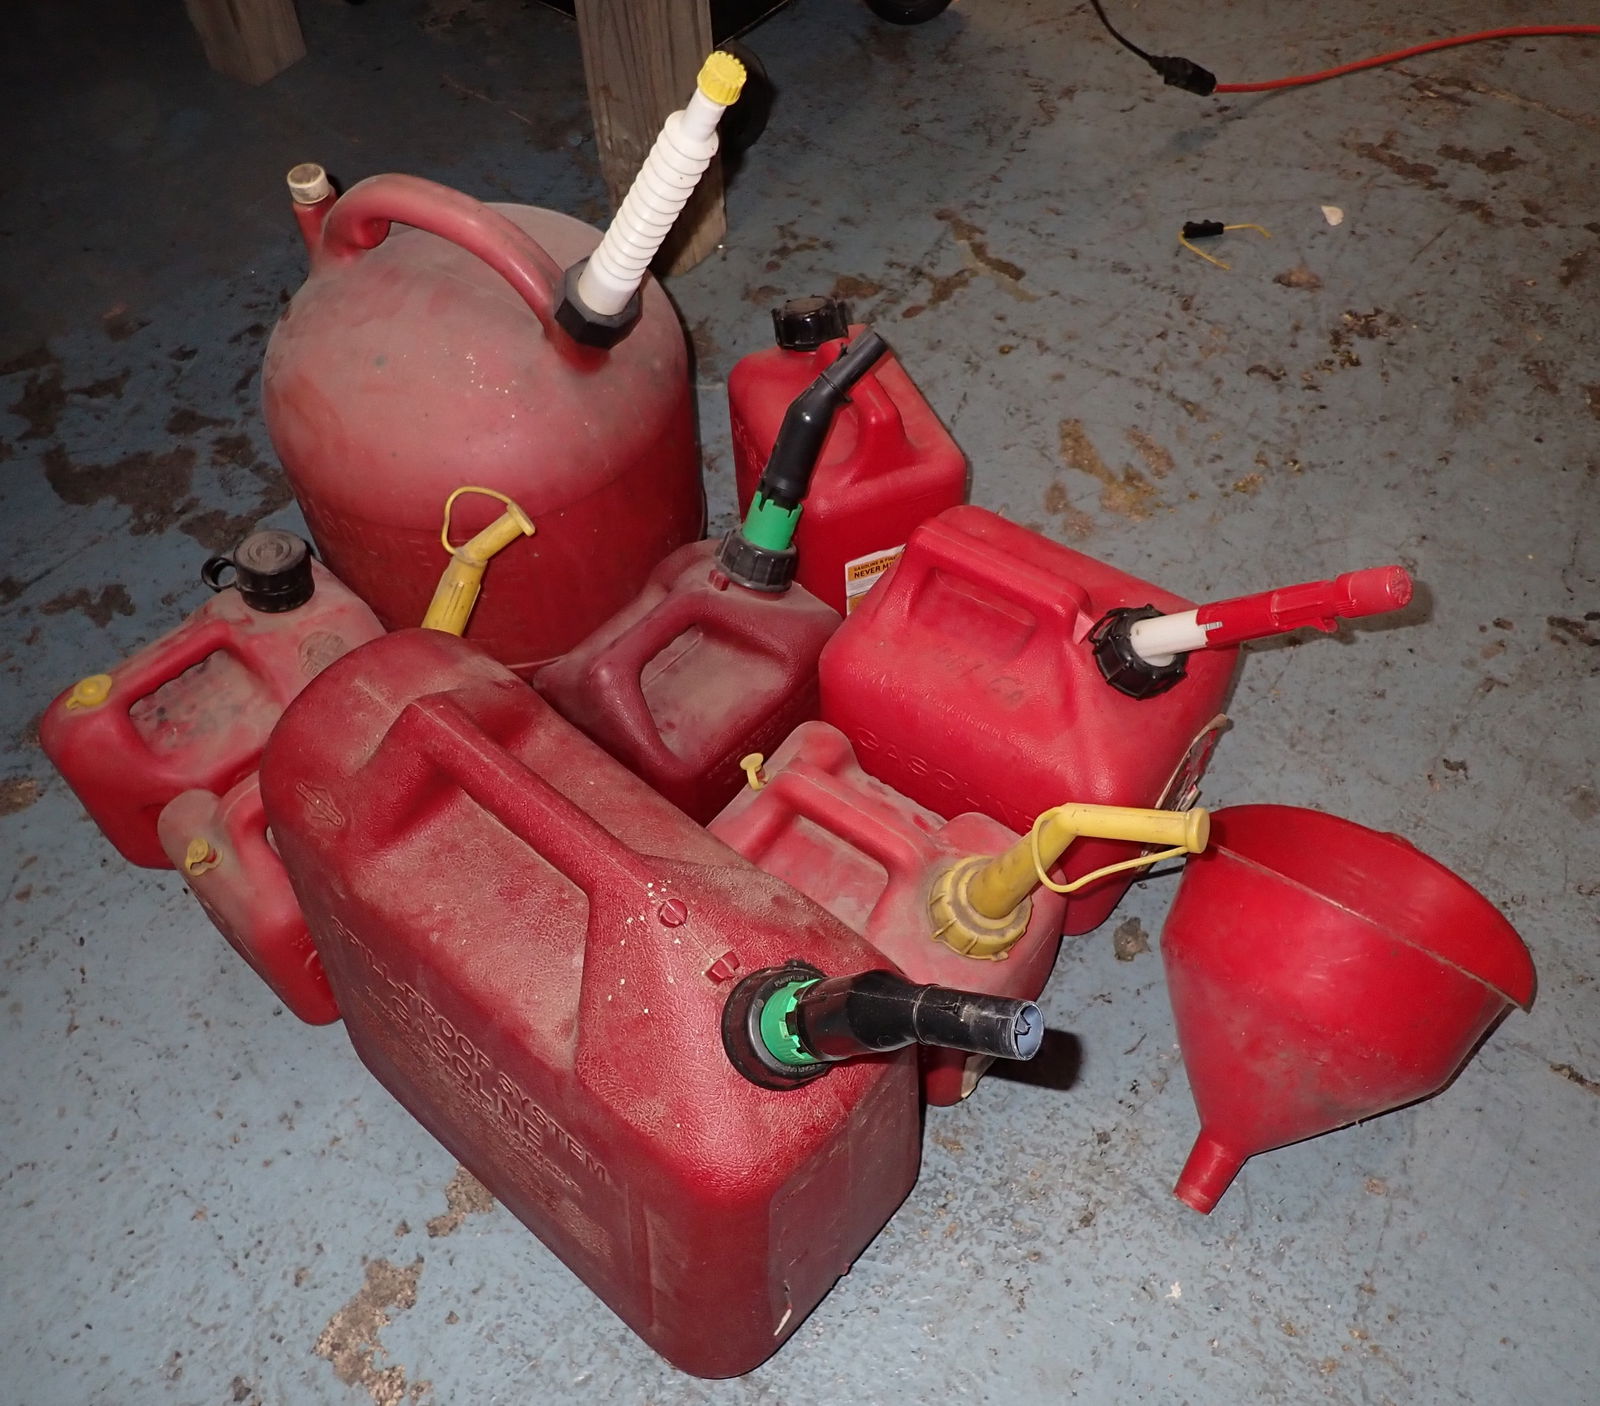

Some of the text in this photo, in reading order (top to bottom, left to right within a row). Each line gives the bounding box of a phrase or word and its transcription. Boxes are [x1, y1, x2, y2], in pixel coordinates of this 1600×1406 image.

[853, 565, 881, 579] NEVER
[391, 995, 544, 1144] GASOLINE
[499, 1071, 612, 1184] SYSTEM
